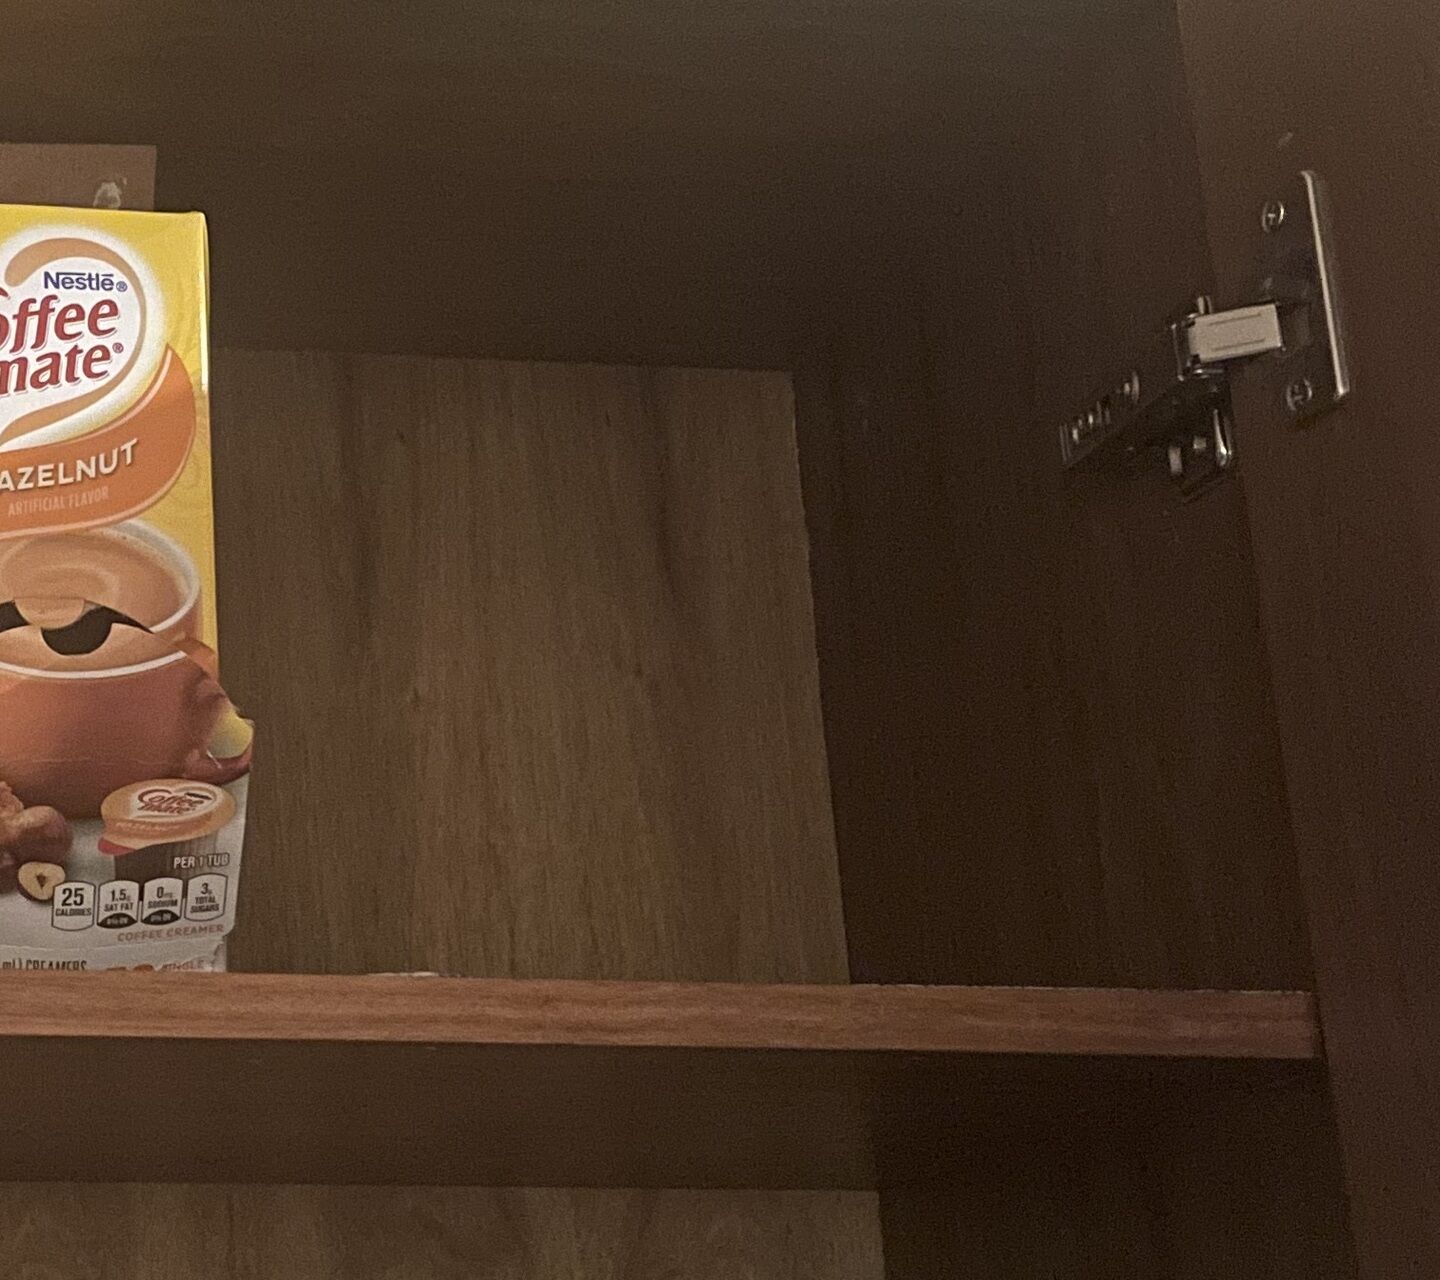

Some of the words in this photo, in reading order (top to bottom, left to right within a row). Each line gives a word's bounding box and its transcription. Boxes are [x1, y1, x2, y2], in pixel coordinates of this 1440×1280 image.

[8, 496, 66, 517] ARTIFICIAL
[68, 486, 109, 511] FLAVOR
[174, 856, 195, 869] PER
[207, 854, 230, 867] TUB
[61, 888, 84, 906] 25
[120, 902, 134, 911] FAT
[118, 930, 165, 942] COFFEE
[166, 924, 224, 937] CREAMER
